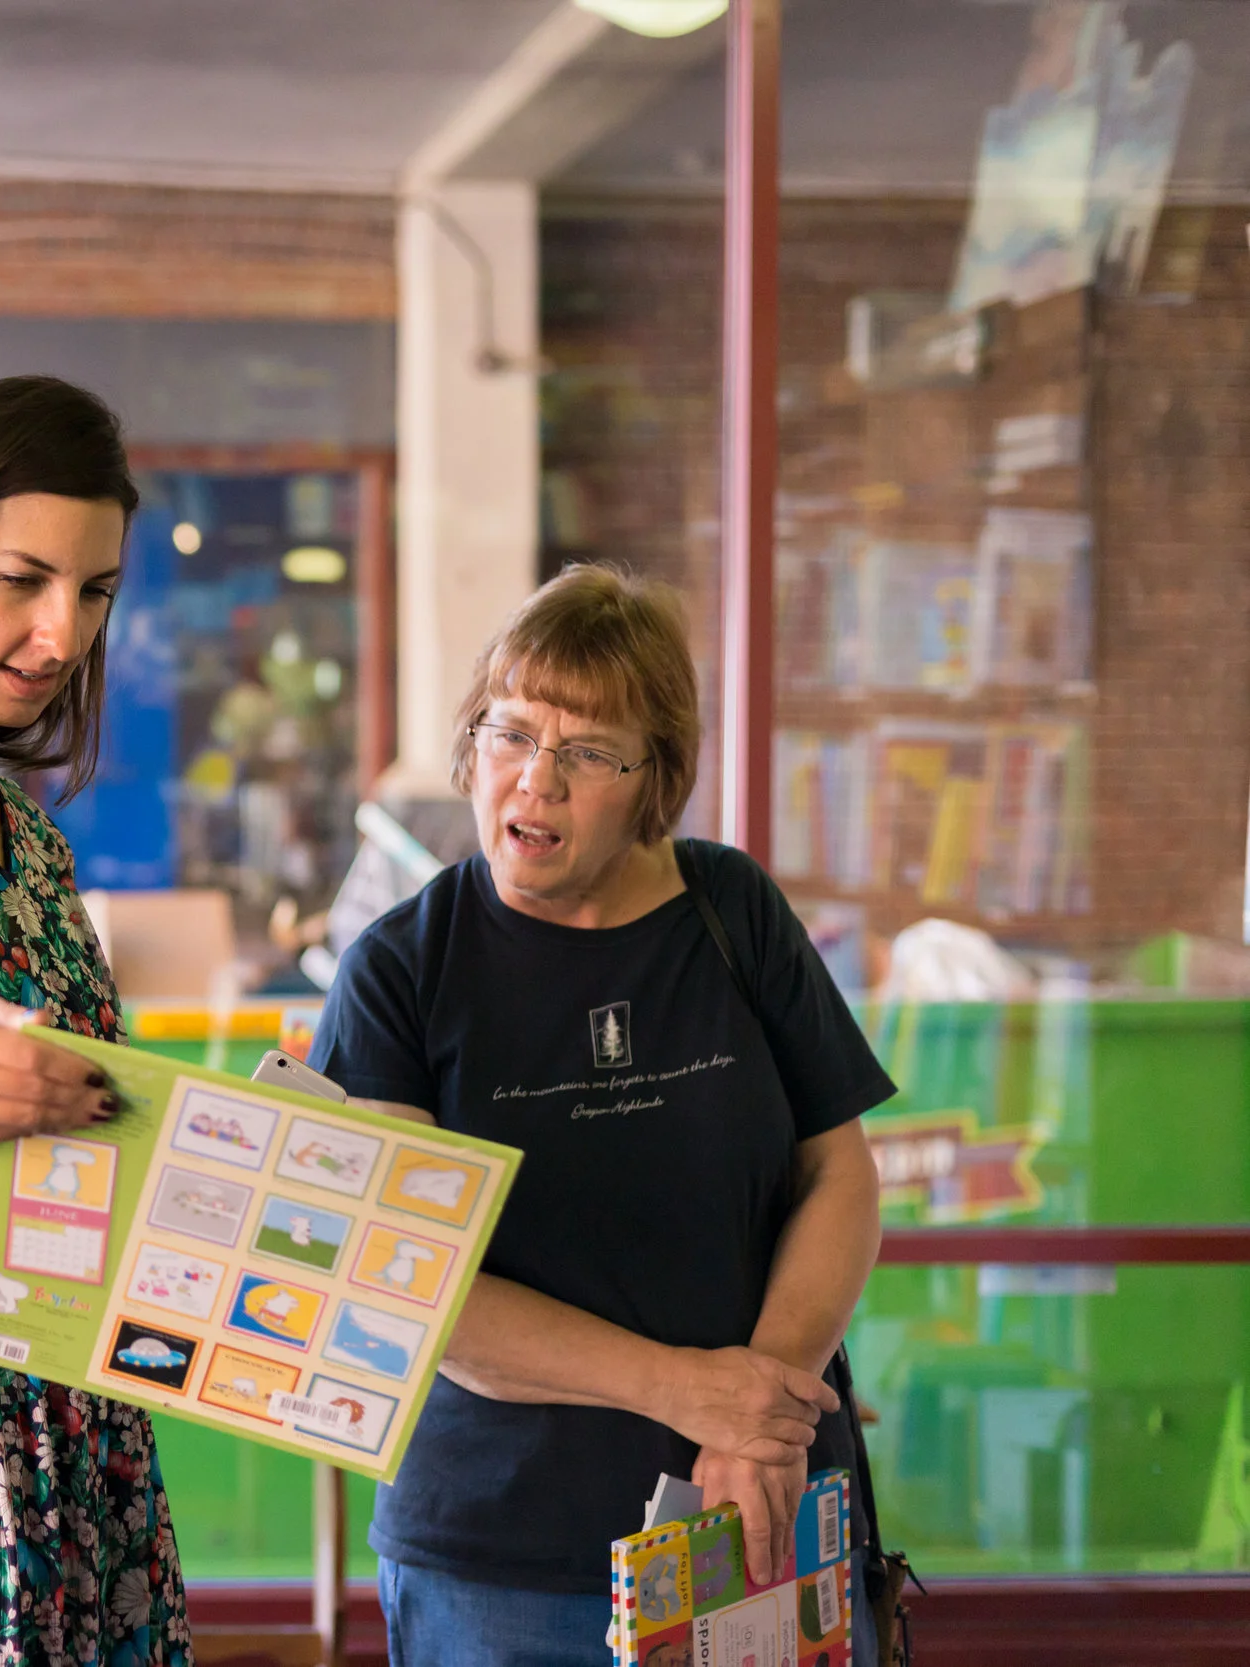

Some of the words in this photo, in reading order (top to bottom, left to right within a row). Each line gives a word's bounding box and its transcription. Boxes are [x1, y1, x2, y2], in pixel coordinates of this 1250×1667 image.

[492, 1086, 508, 1100] In
[510, 1084, 527, 1098] the
[610, 1076, 645, 1091] forgets
[659, 1067, 689, 1080] count
[690, 1059, 709, 1072] the
[571, 1103, 611, 1119] Oregon
[610, 1096, 665, 1116] Highlands
[680, 1552, 688, 1577] toy
[680, 1580, 689, 1607] soft
